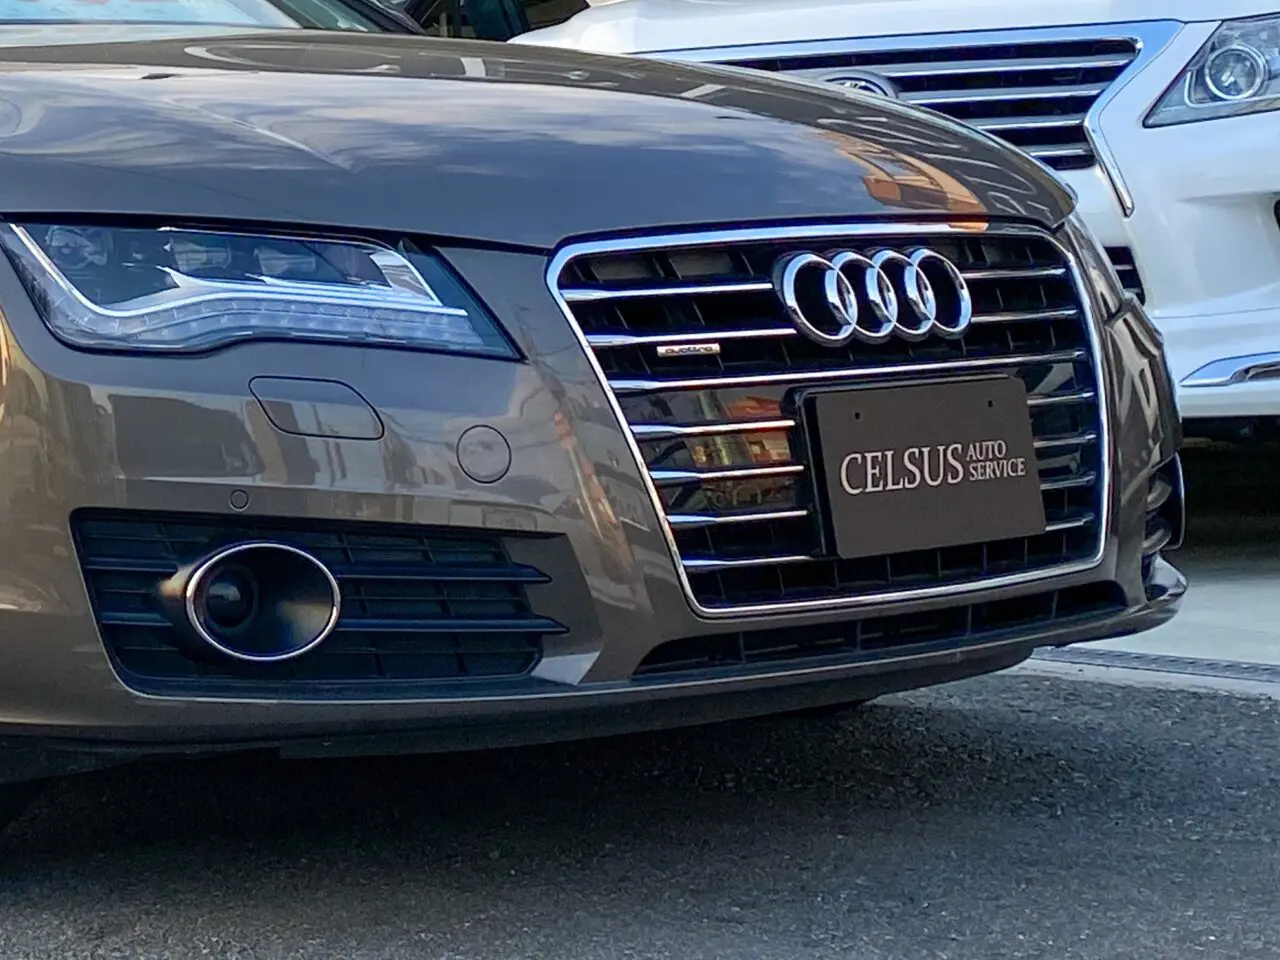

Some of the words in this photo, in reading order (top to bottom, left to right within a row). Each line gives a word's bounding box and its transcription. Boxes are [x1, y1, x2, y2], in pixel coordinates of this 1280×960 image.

[966, 440, 1007, 461] AUTO
[840, 443, 964, 495] CELSUS
[969, 458, 1026, 480] SERVICE
